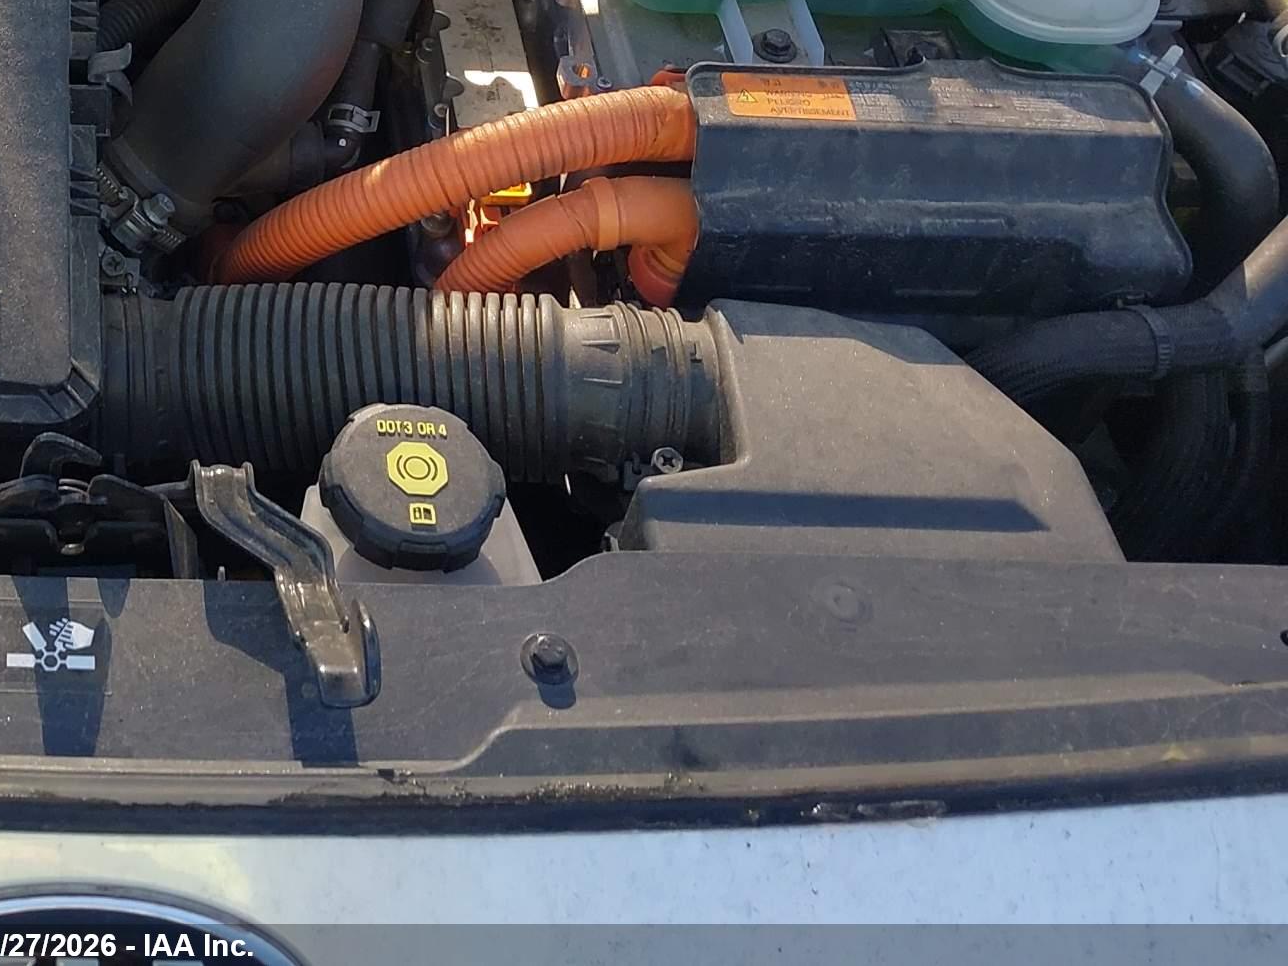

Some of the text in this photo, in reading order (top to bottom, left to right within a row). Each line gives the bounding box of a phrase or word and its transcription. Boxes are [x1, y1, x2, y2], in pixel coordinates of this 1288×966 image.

[376, 419, 447, 436] DOT 3 OR 4
